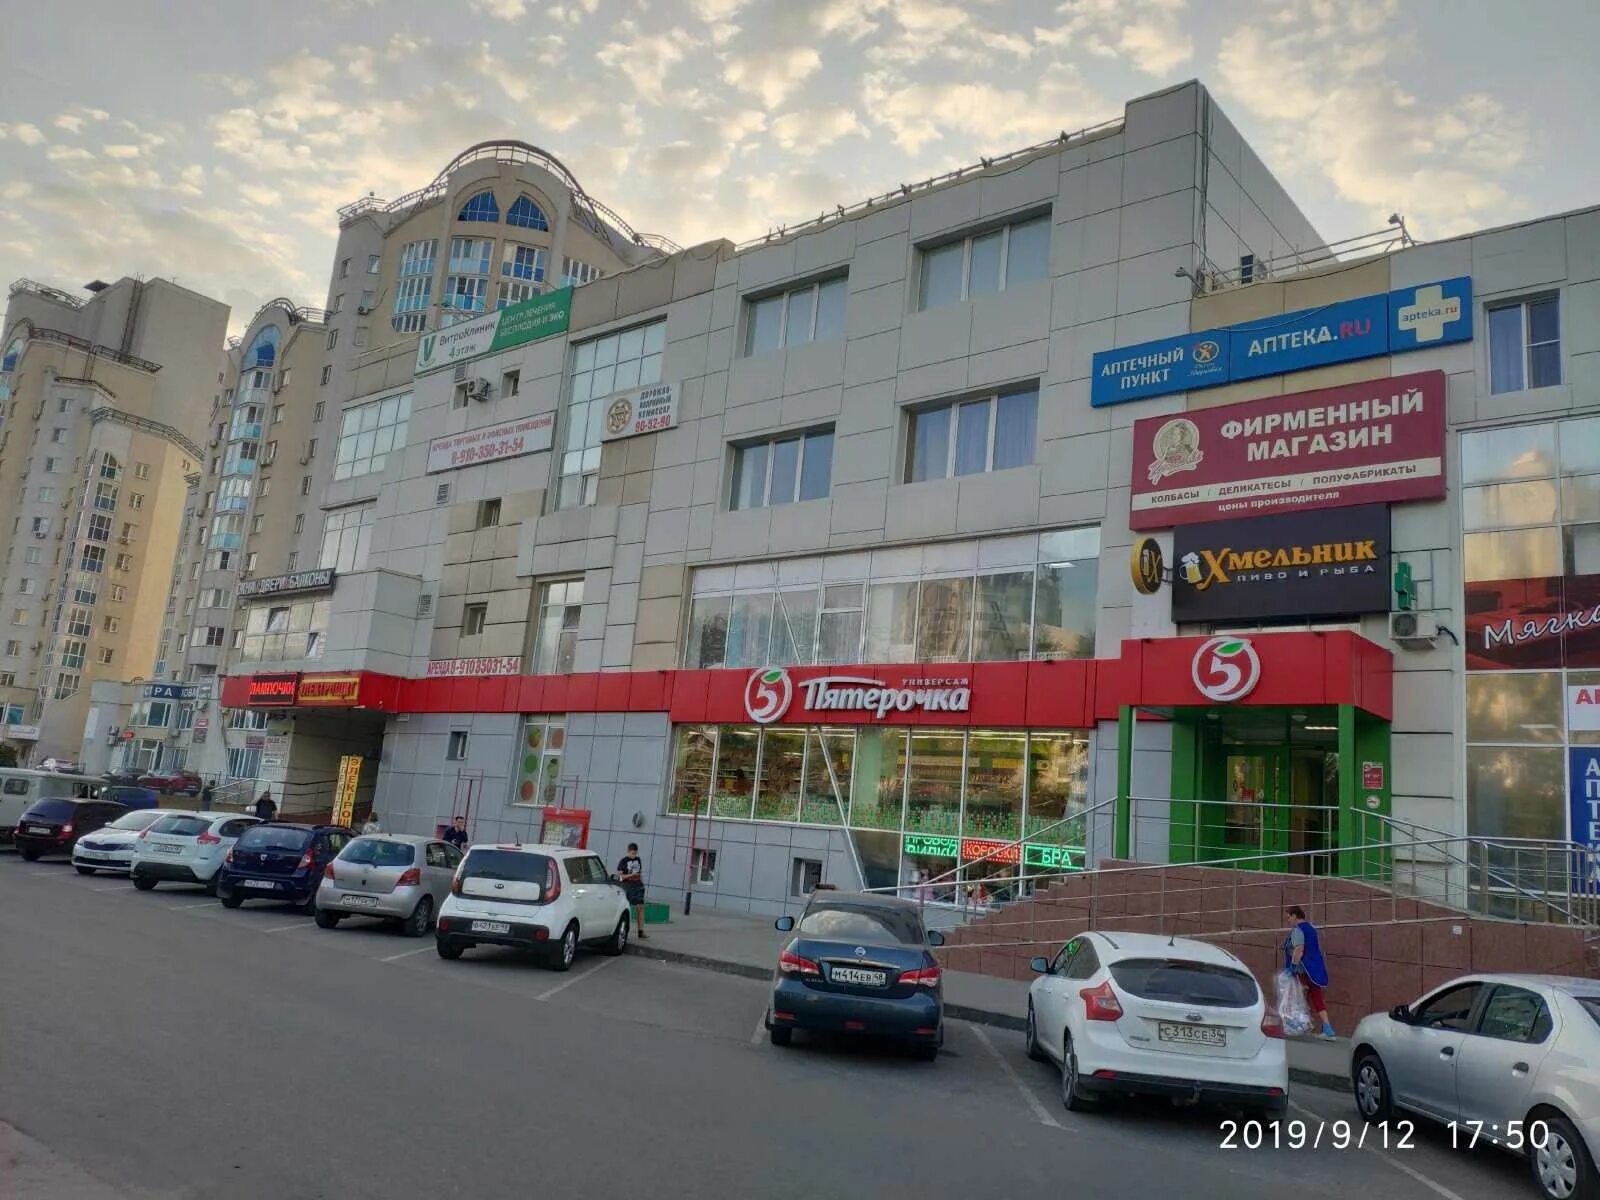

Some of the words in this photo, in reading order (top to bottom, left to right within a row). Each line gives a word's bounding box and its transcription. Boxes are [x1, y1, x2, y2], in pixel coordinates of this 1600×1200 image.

[1402, 305, 1458, 322] apteka.ru
[439, 320, 496, 346] ВитроКлиник
[1101, 346, 1185, 377] АПТЕЧНЫЙ
[1120, 368, 1171, 390] ПУНКТ
[1220, 388, 1424, 440] ФИРМЕННЫЙ
[1247, 423, 1393, 462] МАГАЗИН
[1151, 490, 1200, 504] КОЛБАСЫ
[1218, 480, 1292, 497] ДЕЛИКАТЕСЫ
[1312, 464, 1417, 486] ПОЛУФАБРИКАТЫ
[1218, 501, 1249, 513] цены
[1250, 490, 1340, 509] производителя
[1237, 572, 1288, 583] ПИВО
[1298, 569, 1309, 577] И
[1319, 564, 1376, 577] РЫБА
[249, 681, 295, 695] ЛАМПОЧКИ
[902, 678, 969, 686] УНИВЕРСАМ
[798, 676, 971, 719] Пятерочка
[1042, 847, 1072, 866] БРА
